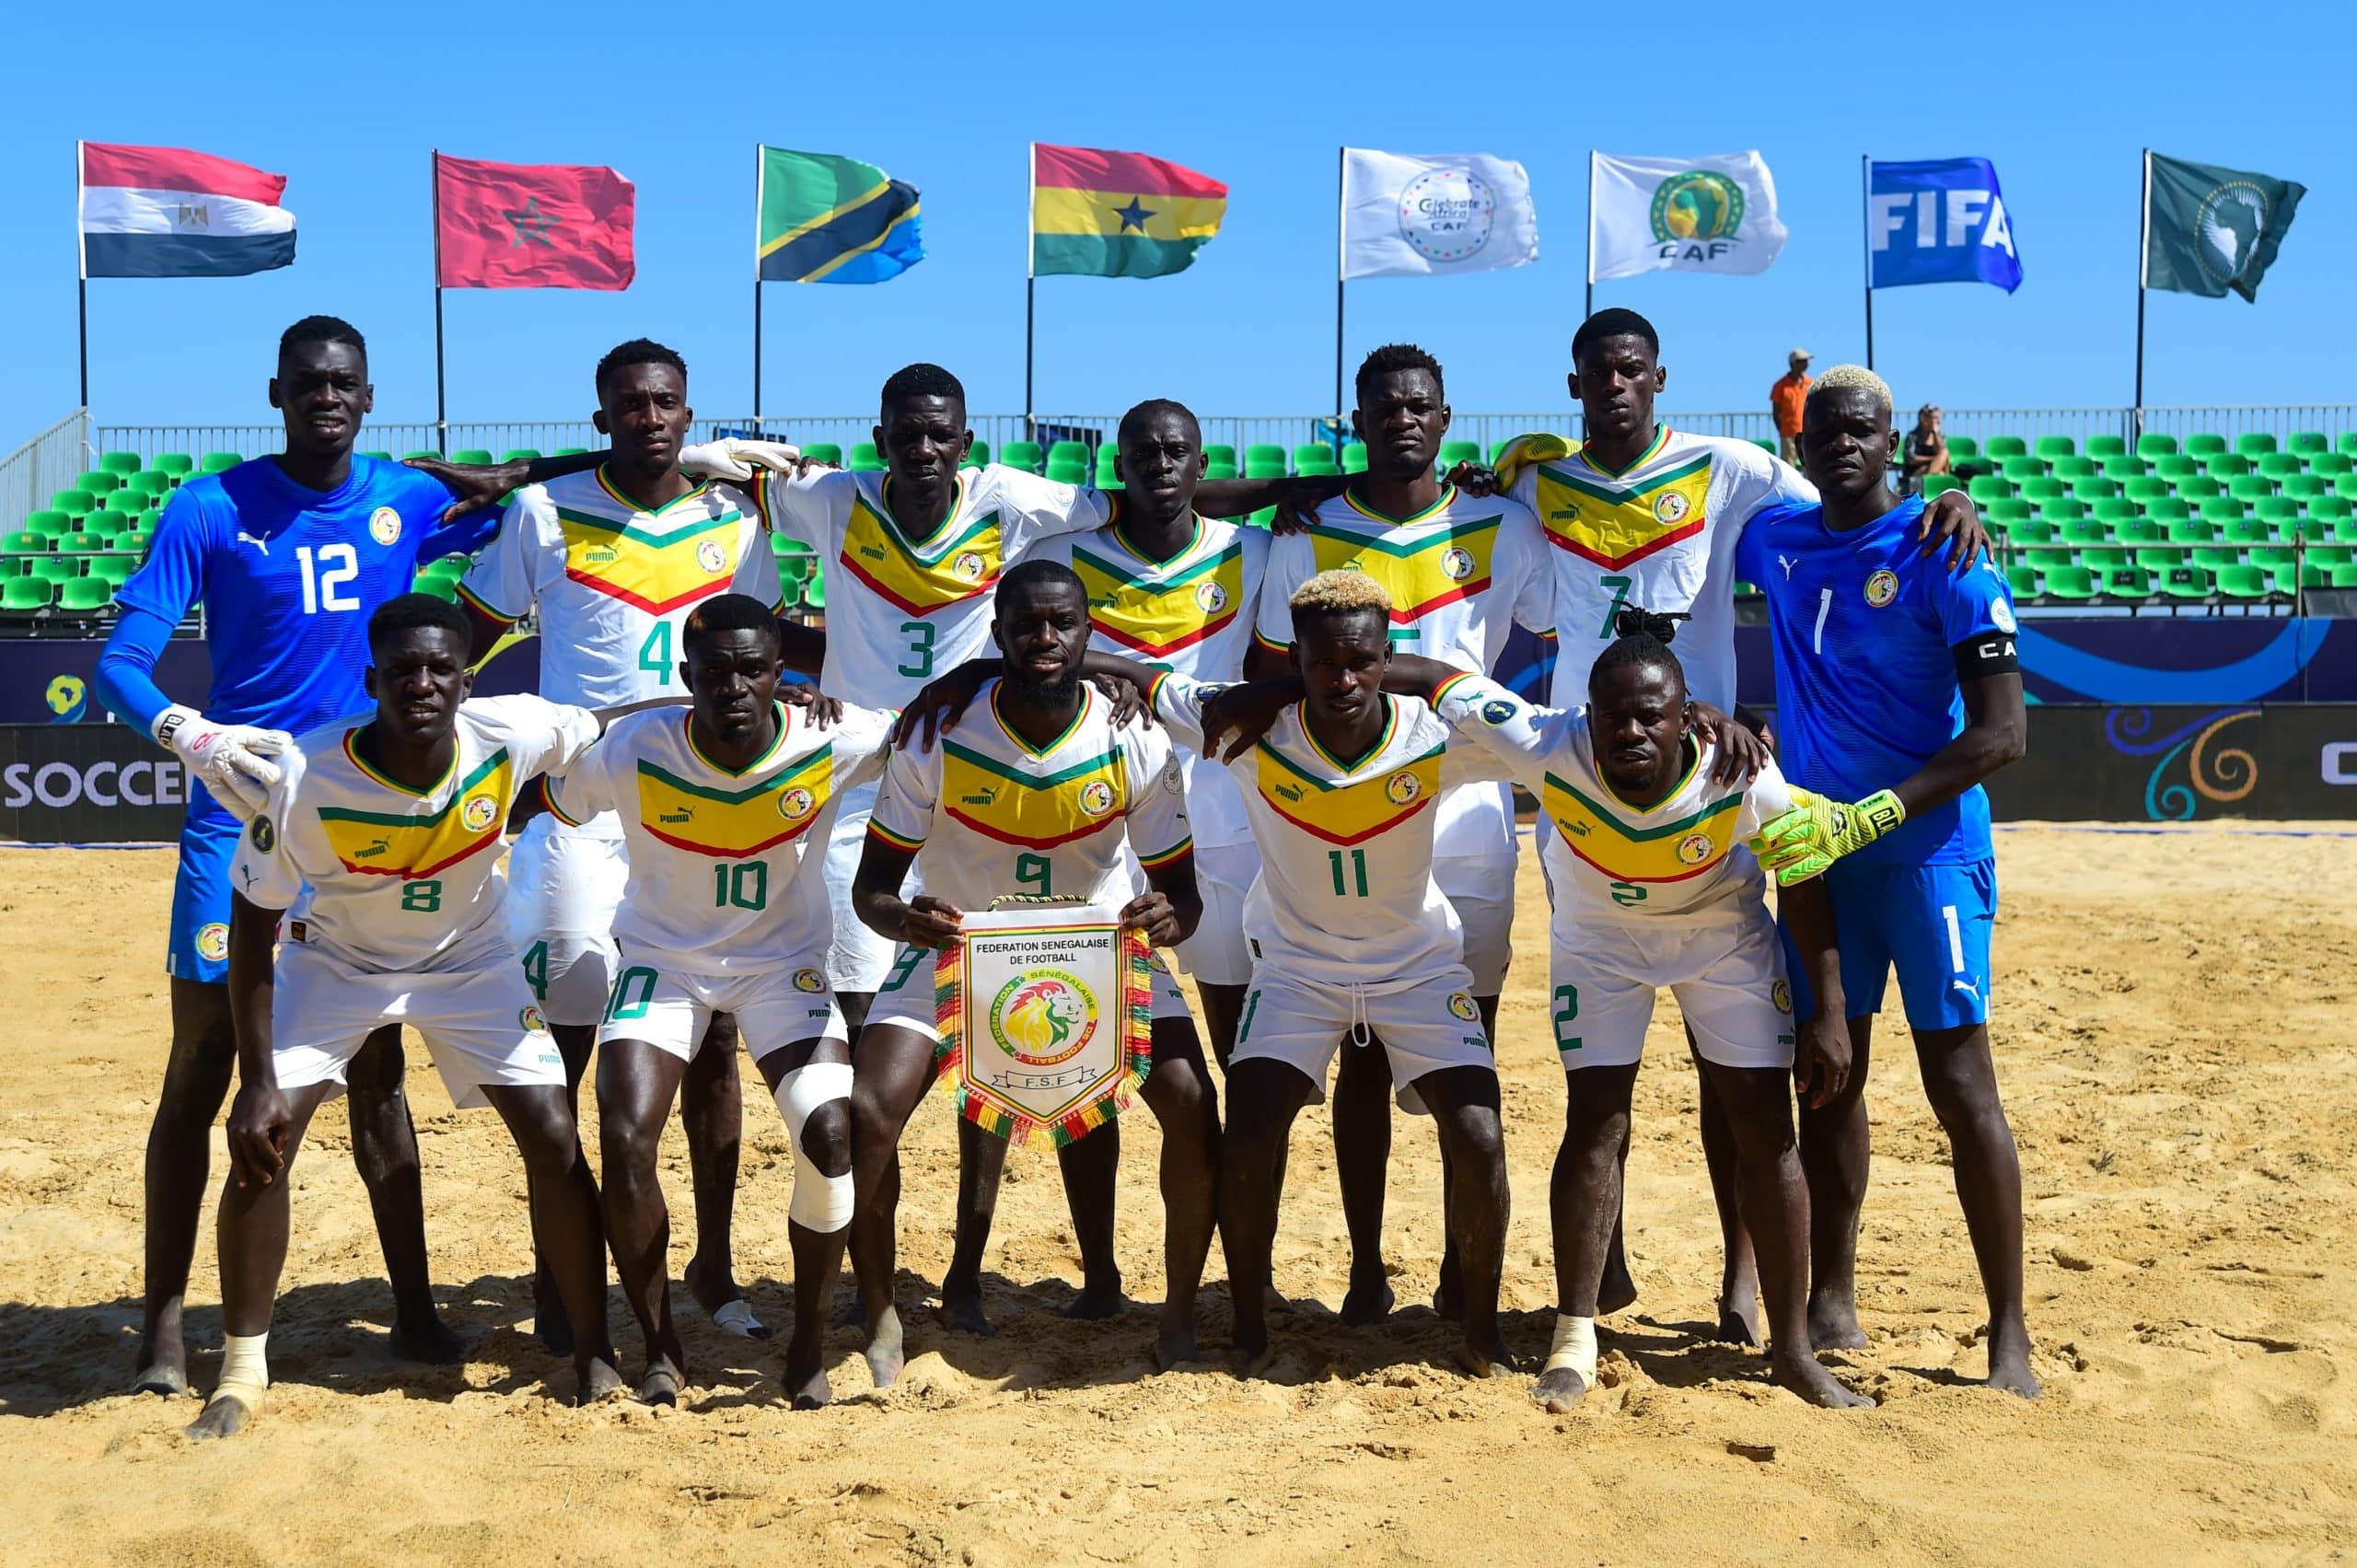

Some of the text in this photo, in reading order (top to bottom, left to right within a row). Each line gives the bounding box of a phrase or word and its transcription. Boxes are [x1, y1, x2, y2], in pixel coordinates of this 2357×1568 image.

[1871, 190, 2014, 259] FIFA
[1659, 242, 1728, 262] CAF
[1550, 509, 1576, 520] PUMA
[586, 552, 614, 562] PUMA
[862, 545, 886, 562] PUMA
[296, 543, 360, 614] 12
[1599, 575, 1632, 639] 7
[1814, 588, 1832, 655] 1
[639, 621, 673, 685] 4
[899, 621, 935, 678] 3
[4, 761, 192, 807] SOCCE
[1275, 784, 1299, 802] PUMA
[962, 796, 991, 805] PUMA
[660, 815, 689, 823] PUMA
[1560, 819, 1586, 837] PUMA
[354, 847, 386, 861] PUMA
[714, 861, 768, 911] 10
[1016, 853, 1051, 898] 9
[1329, 849, 1368, 897] 11
[401, 880, 442, 912] 8
[976, 939, 1109, 953] FEDERATION SENEGALAISE
[1943, 905, 1965, 972] 1
[522, 940, 548, 1001] 4
[1010, 953, 1076, 965] DE FOOTBALL
[1555, 984, 1582, 1051] 2
[1027, 1041, 1083, 1064] FOOTBALL
[1026, 1074, 1066, 1086] F.S.F
